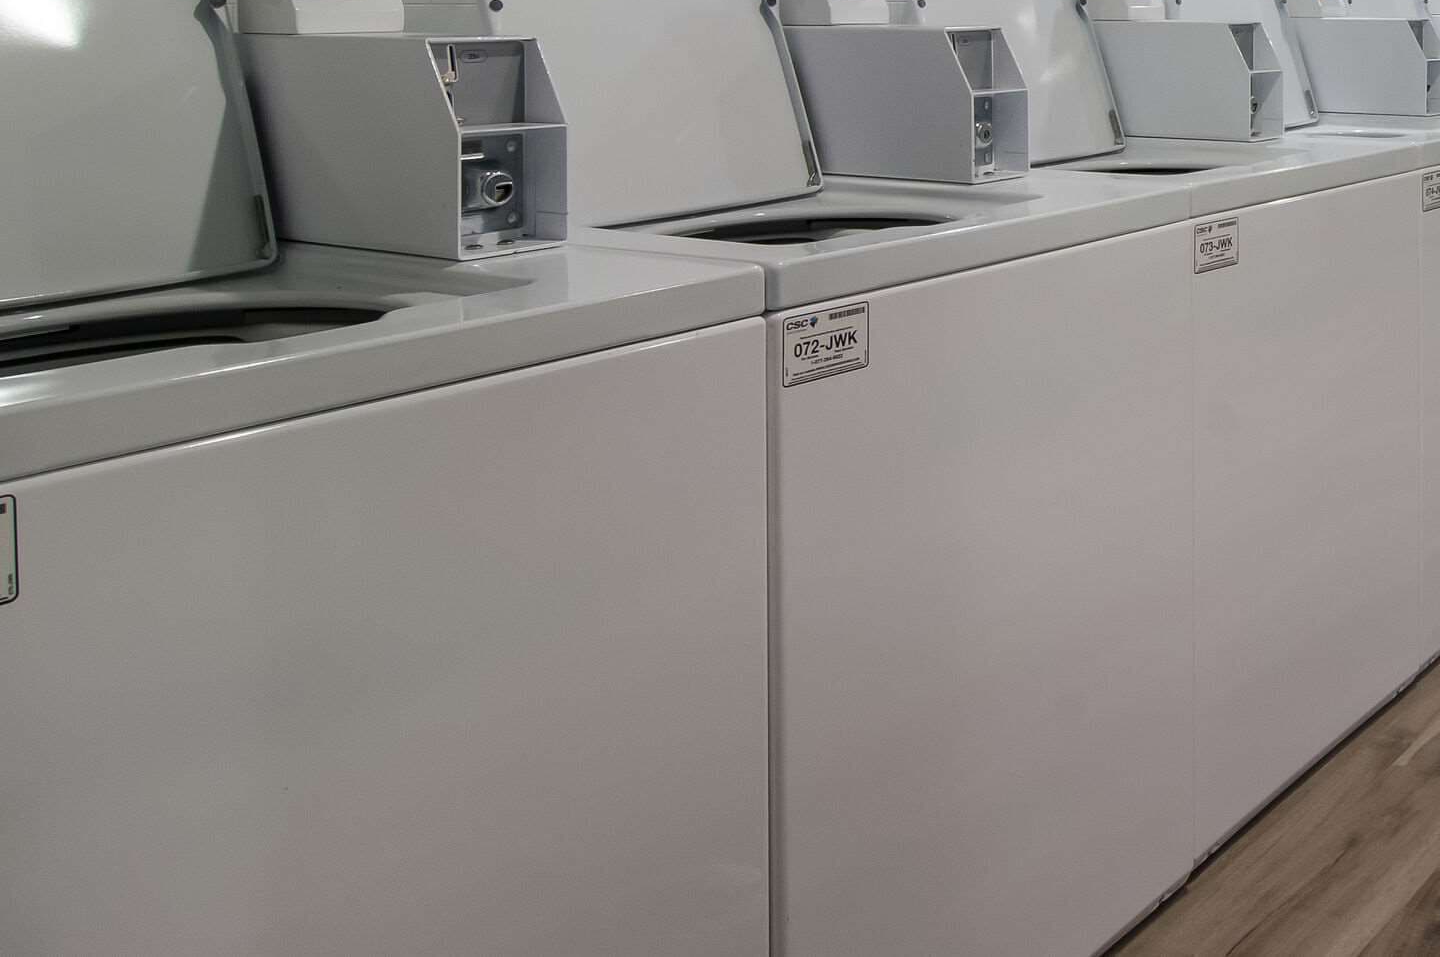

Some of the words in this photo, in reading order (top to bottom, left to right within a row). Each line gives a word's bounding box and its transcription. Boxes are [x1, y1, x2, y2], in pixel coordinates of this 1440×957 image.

[1200, 236, 1233, 254] 073-JWK
[786, 319, 809, 331] CSC
[794, 330, 858, 358] 072-JWK
